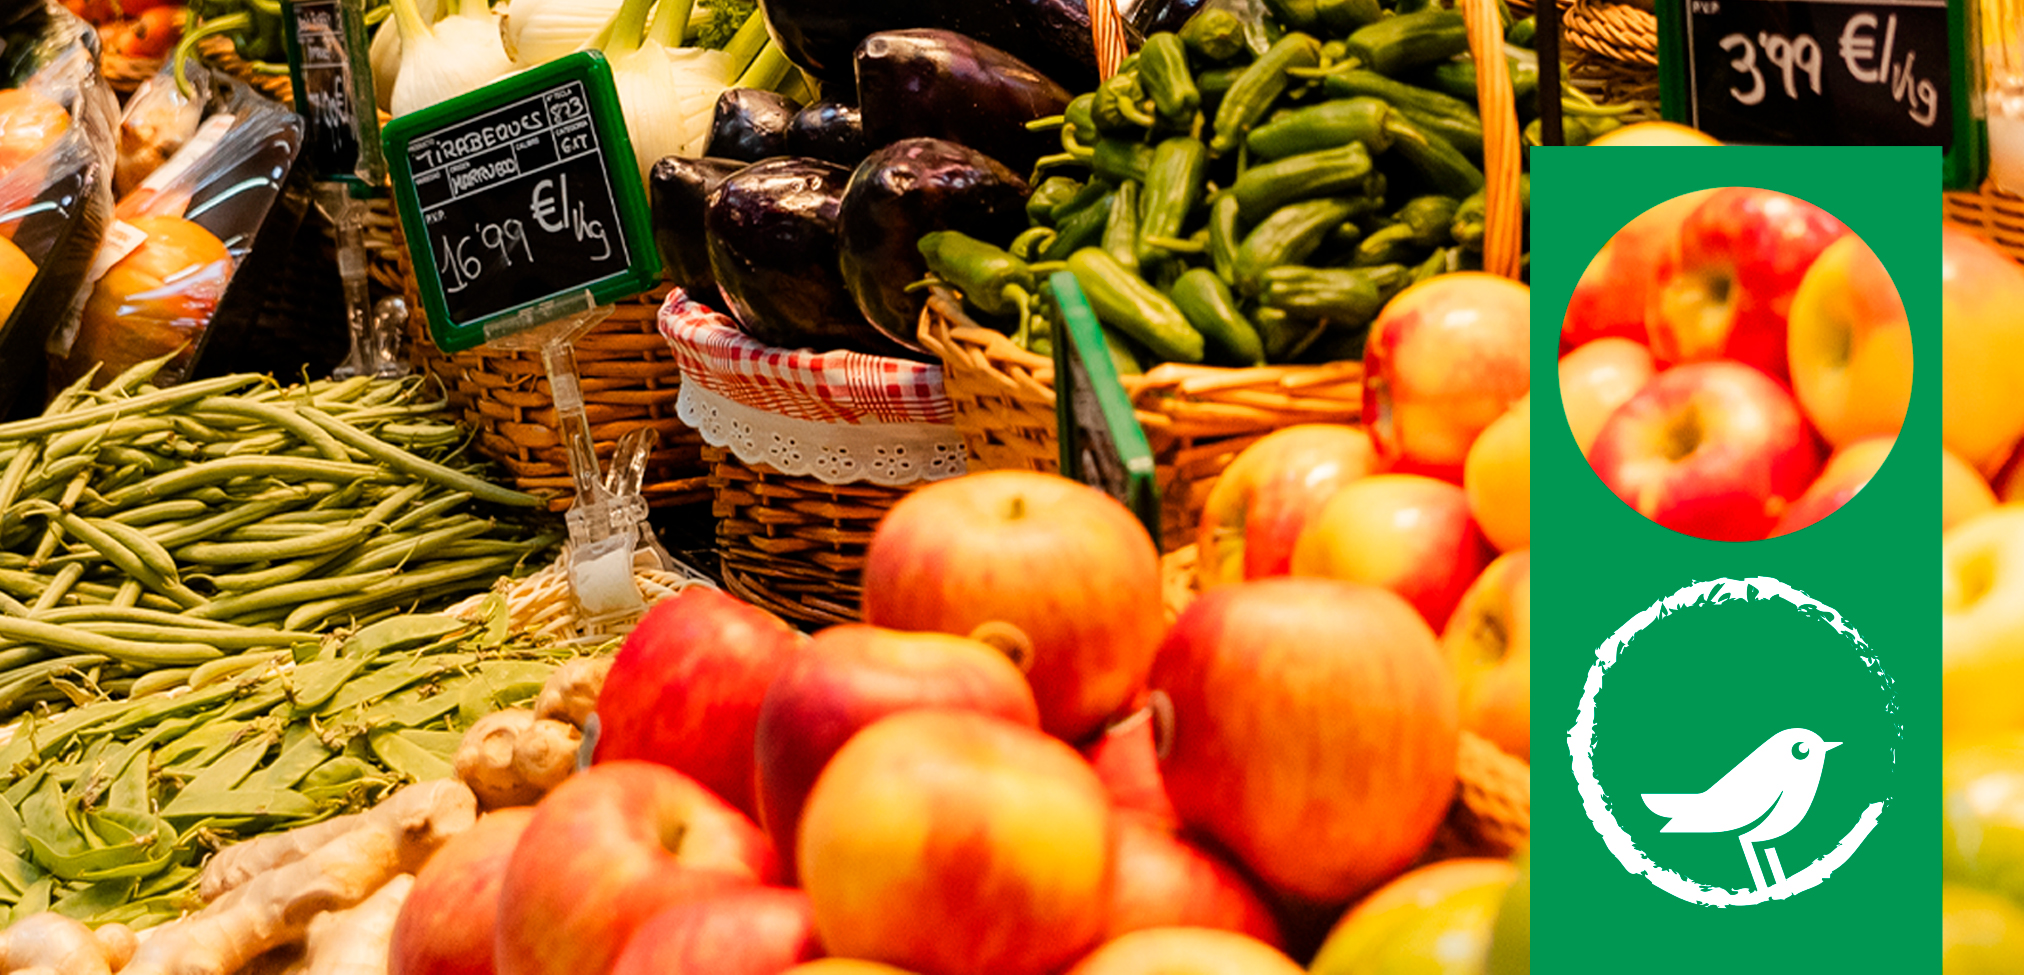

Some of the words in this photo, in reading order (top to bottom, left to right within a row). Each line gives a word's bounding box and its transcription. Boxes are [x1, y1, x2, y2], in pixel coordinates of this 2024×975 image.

[550, 96, 583, 122] 873
[415, 111, 543, 167] TIRABEQUES
[441, 218, 534, 294] 16'99
